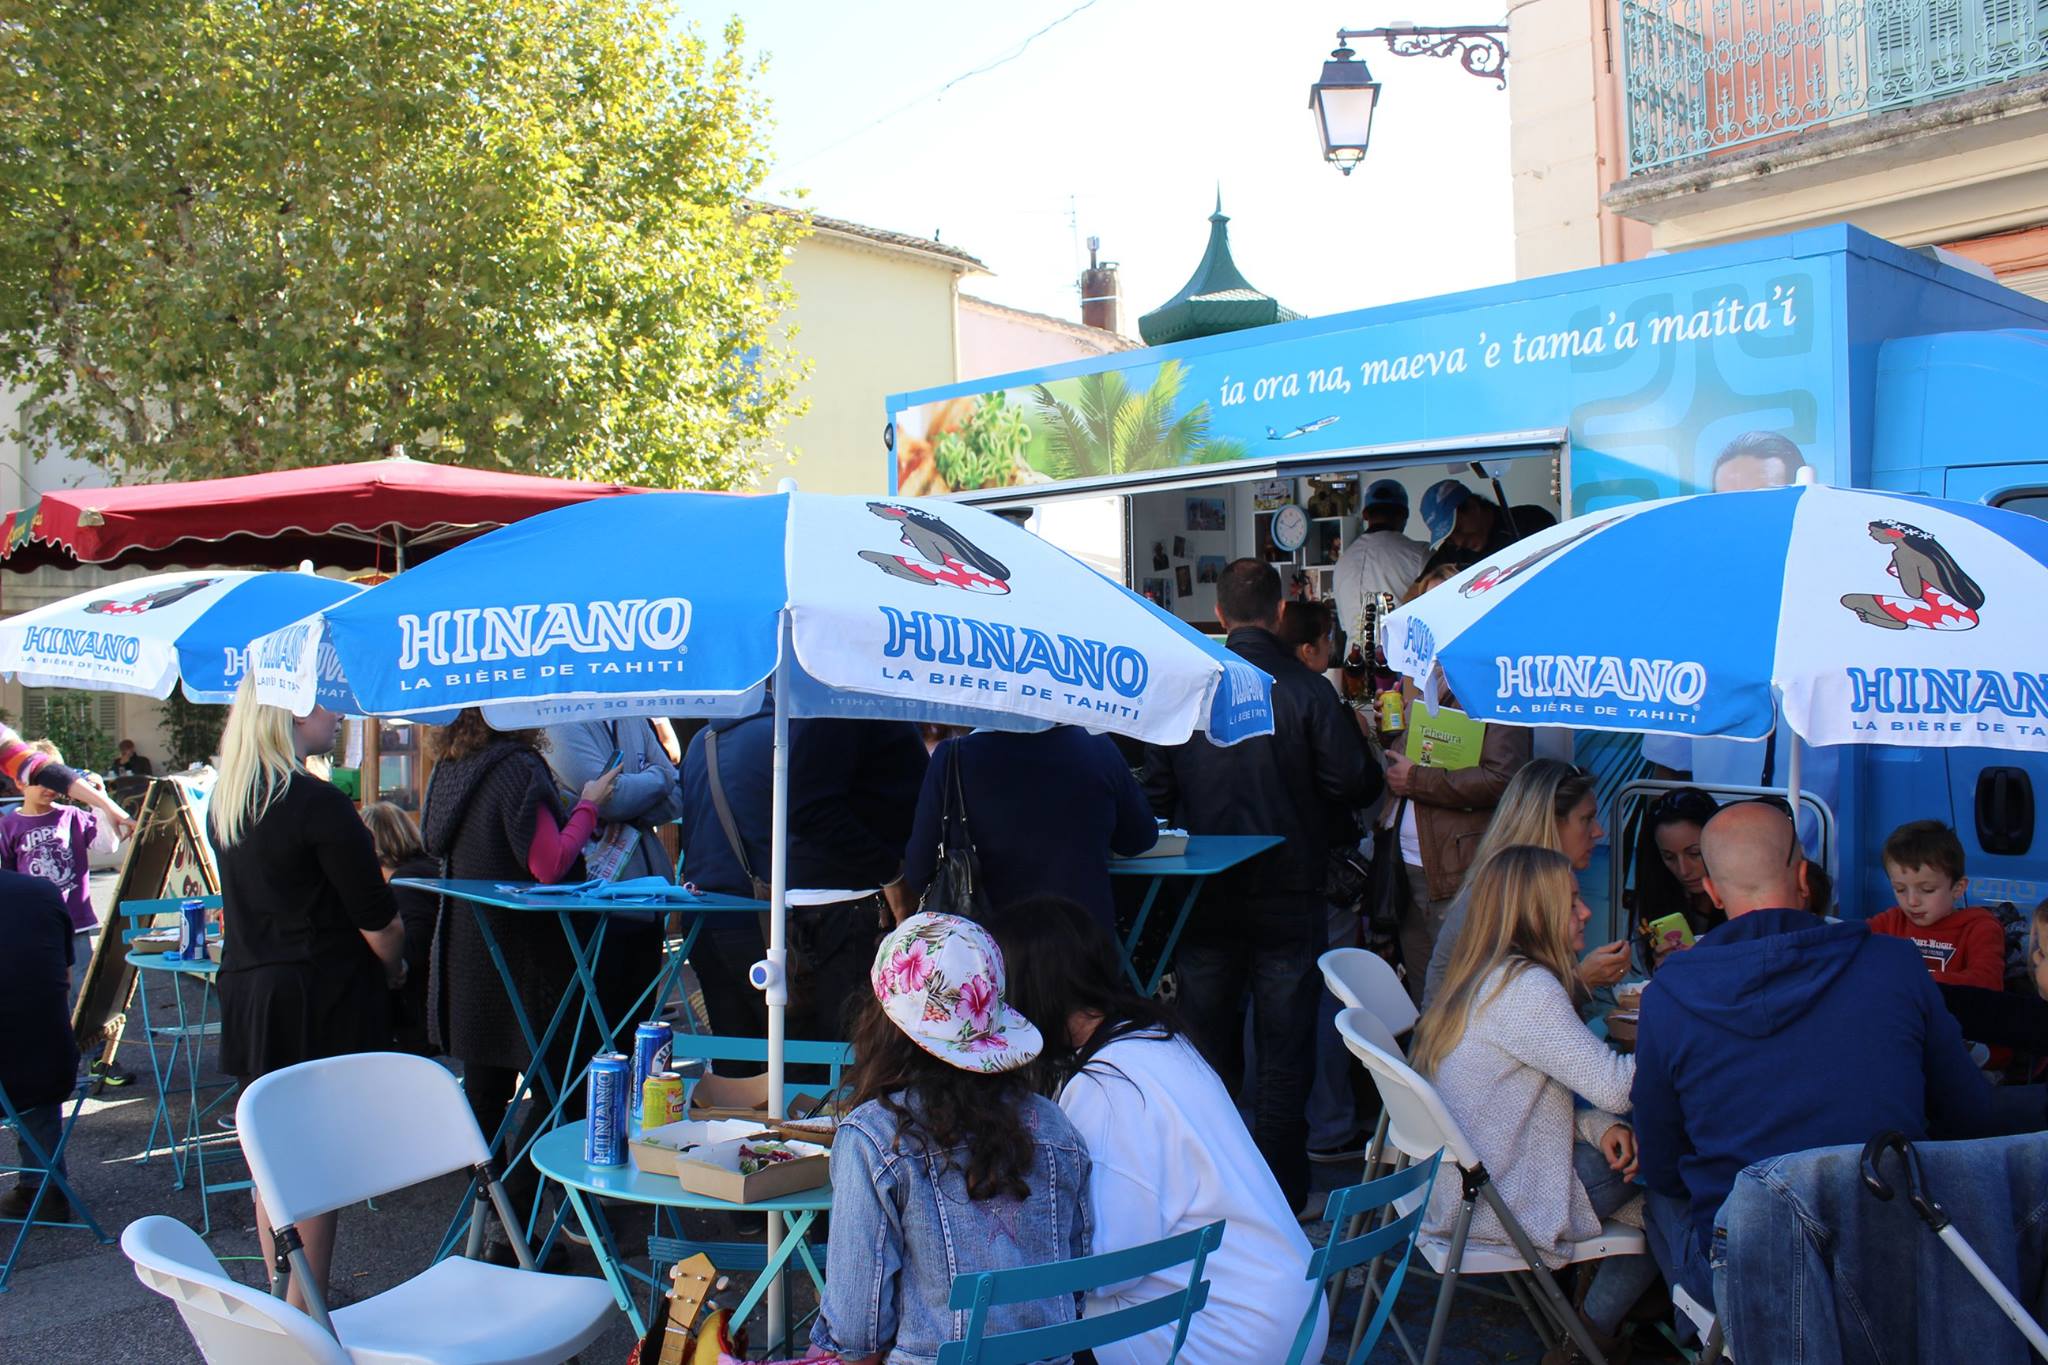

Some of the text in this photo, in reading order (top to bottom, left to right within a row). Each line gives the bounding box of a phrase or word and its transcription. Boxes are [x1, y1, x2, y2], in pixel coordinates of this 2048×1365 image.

[1252, 373, 1300, 402] ora
[1306, 366, 1351, 394] na,
[1360, 348, 1467, 386] maeva
[1512, 311, 1639, 365] tama'a
[23, 625, 140, 665] HINANO
[399, 597, 692, 670] HINANO
[878, 605, 1149, 699] HINANO
[77, 660, 92, 669] DE
[97, 663, 135, 677] TAHITI
[400, 660, 685, 692] LA BIÈRE DE TAHITI
[882, 667, 1140, 721] LA BIÈRE DE TAHITI
[1495, 655, 1706, 706] HINANO
[1846, 667, 2048, 719] HINAN
[1496, 701, 1696, 724] LA BIÈRE DE TAHITI
[1852, 719, 2047, 736] LA BIÈRE DE TA
[593, 1071, 612, 1164] HINANO
